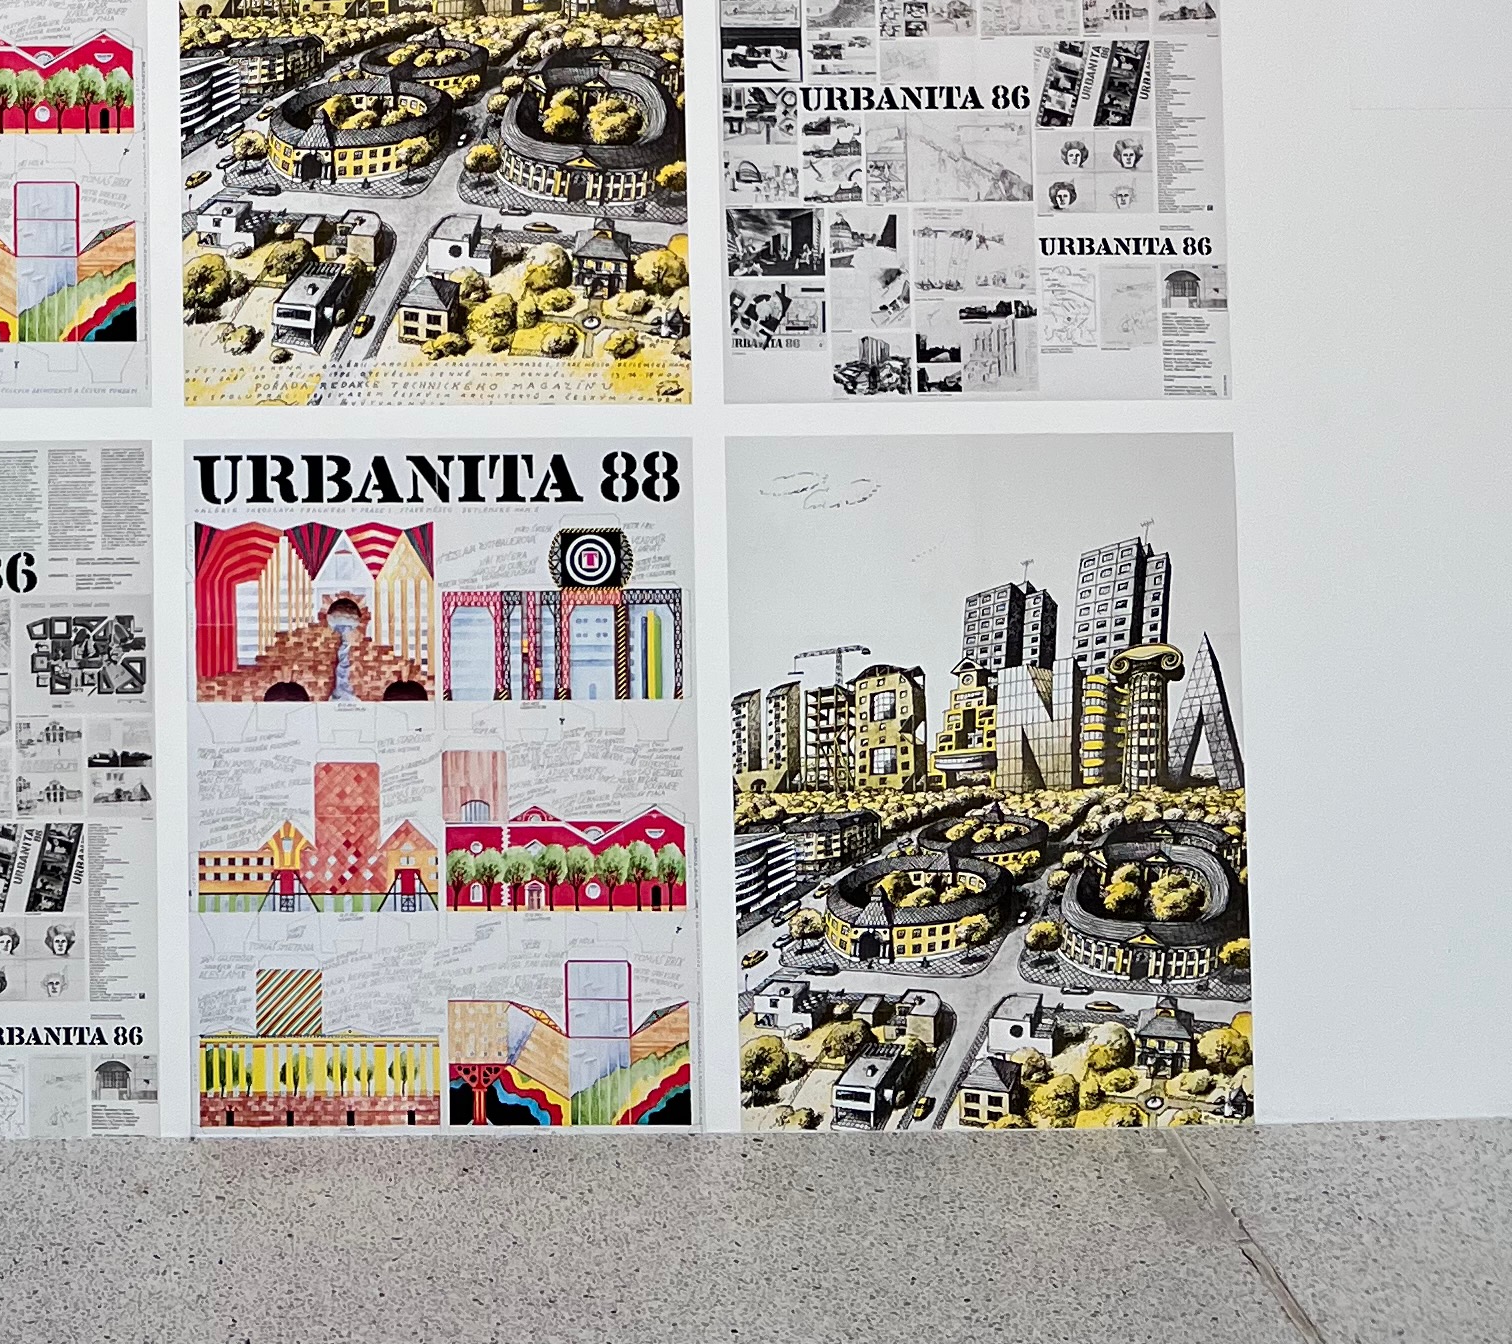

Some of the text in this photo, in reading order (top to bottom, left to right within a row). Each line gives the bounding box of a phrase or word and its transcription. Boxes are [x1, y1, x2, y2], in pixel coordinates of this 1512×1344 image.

[799, 85, 1030, 111] URBANITA 86
[1038, 237, 1212, 255] URBANITA 86
[193, 452, 583, 504] URBANITA
[600, 450, 680, 502] 88
[113, 1026, 143, 1045] 86
